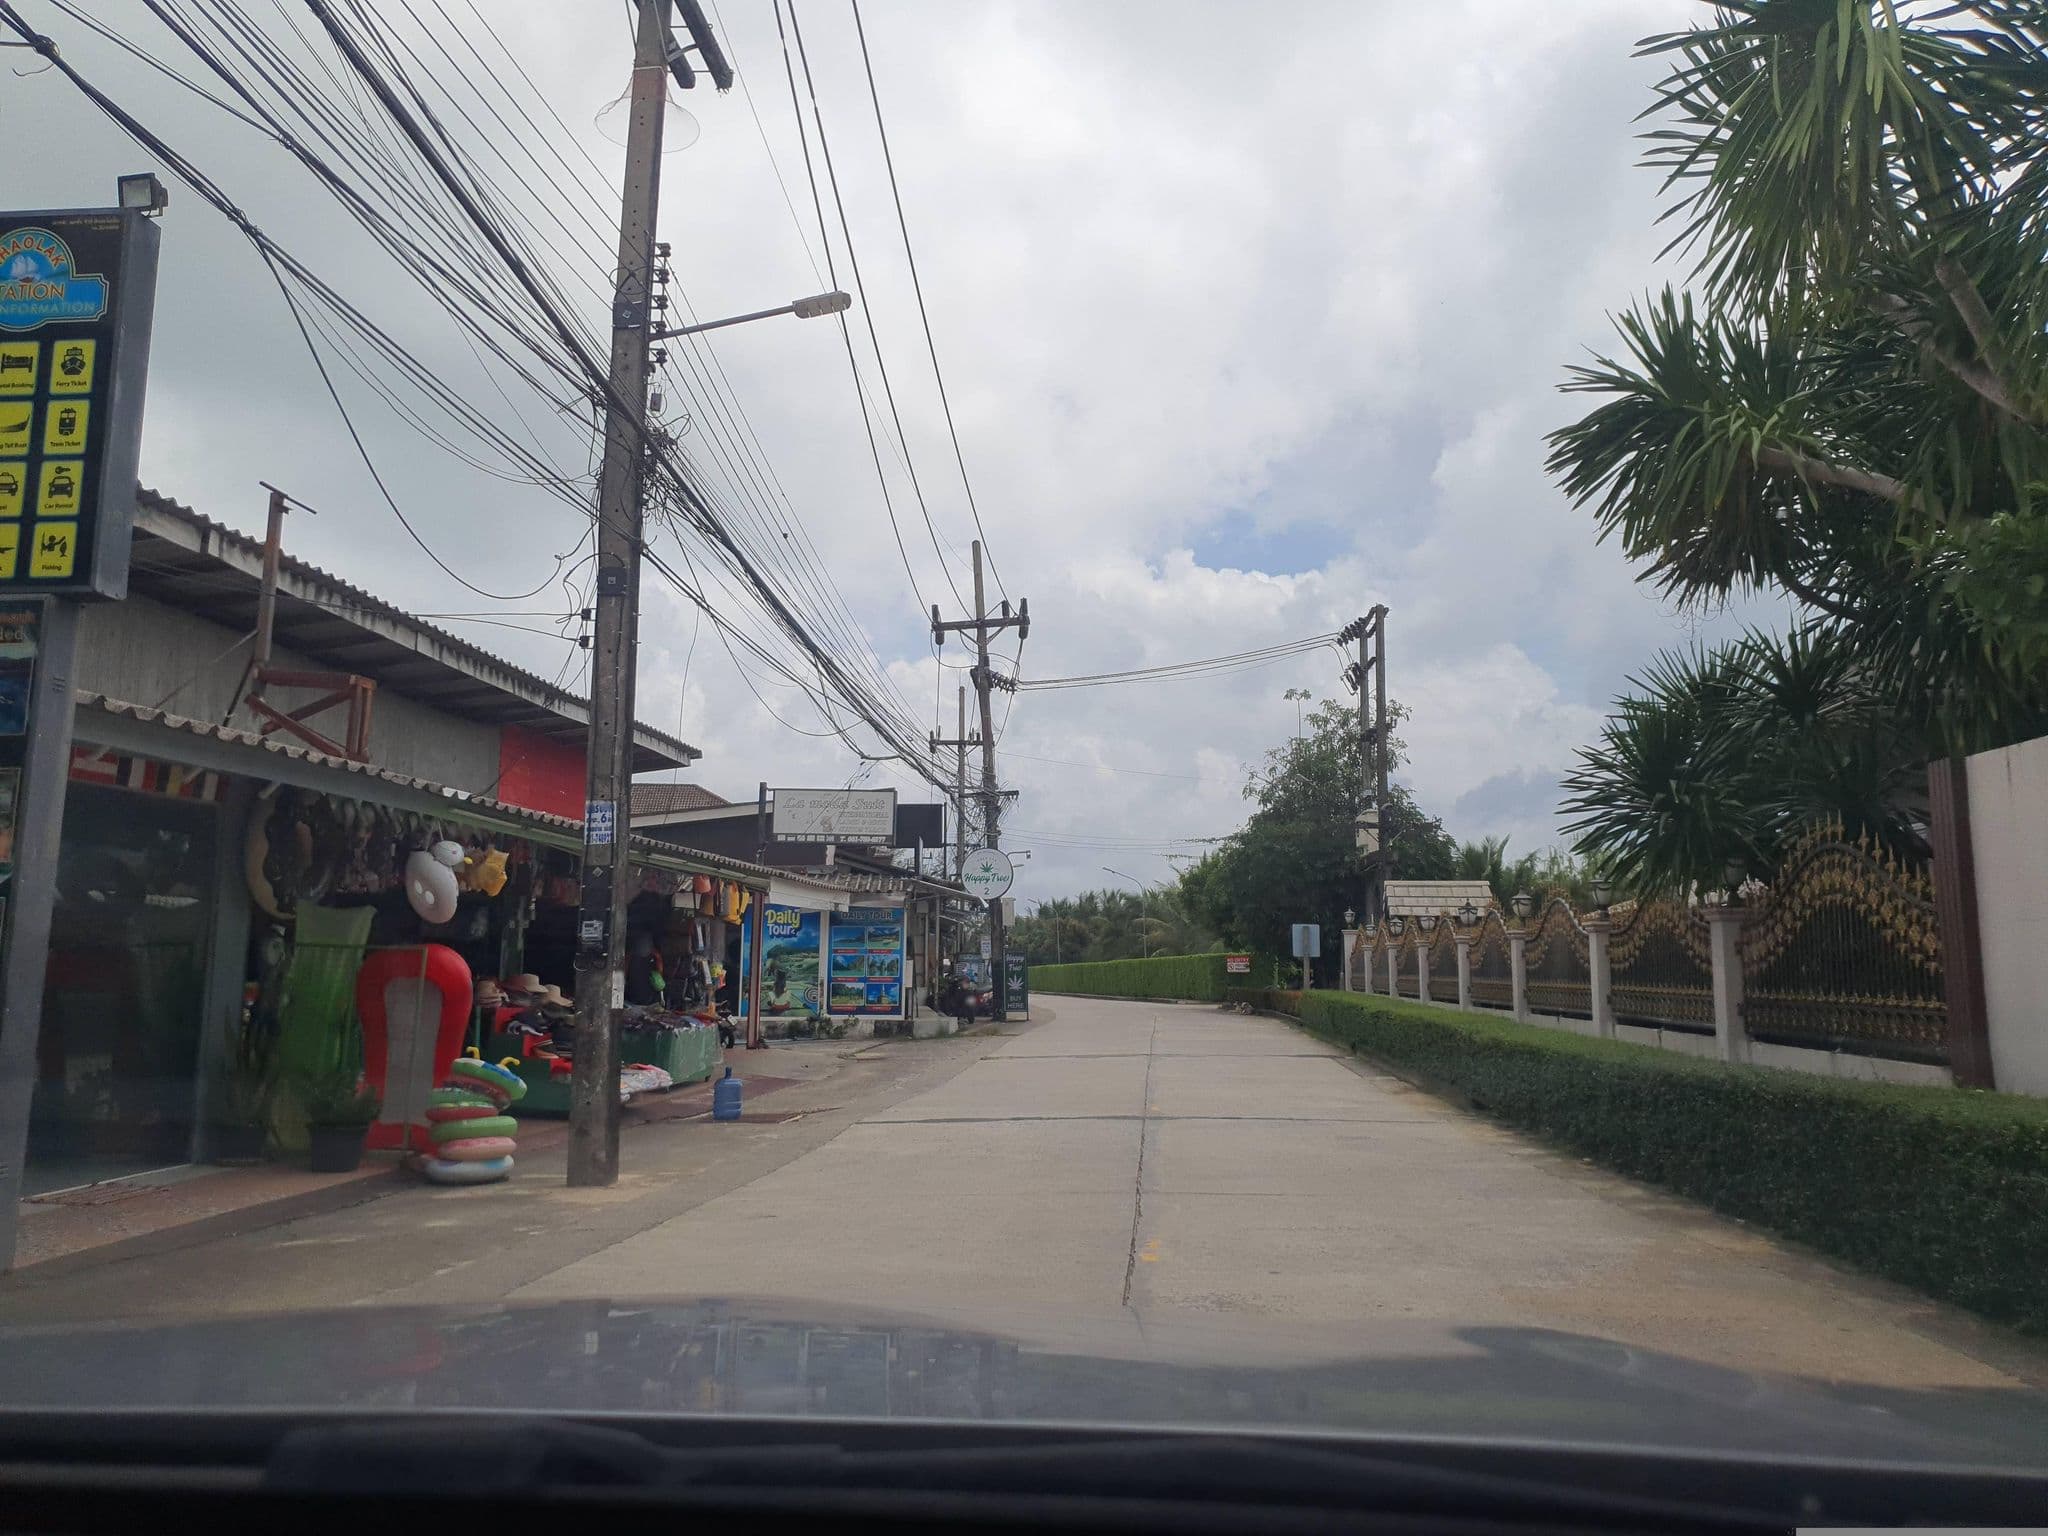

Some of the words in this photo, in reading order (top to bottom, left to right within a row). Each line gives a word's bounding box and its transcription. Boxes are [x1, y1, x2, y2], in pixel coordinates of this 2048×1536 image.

[964, 873, 990, 884] Happy
[984, 887, 990, 895] 2
[765, 909, 800, 928] Daily
